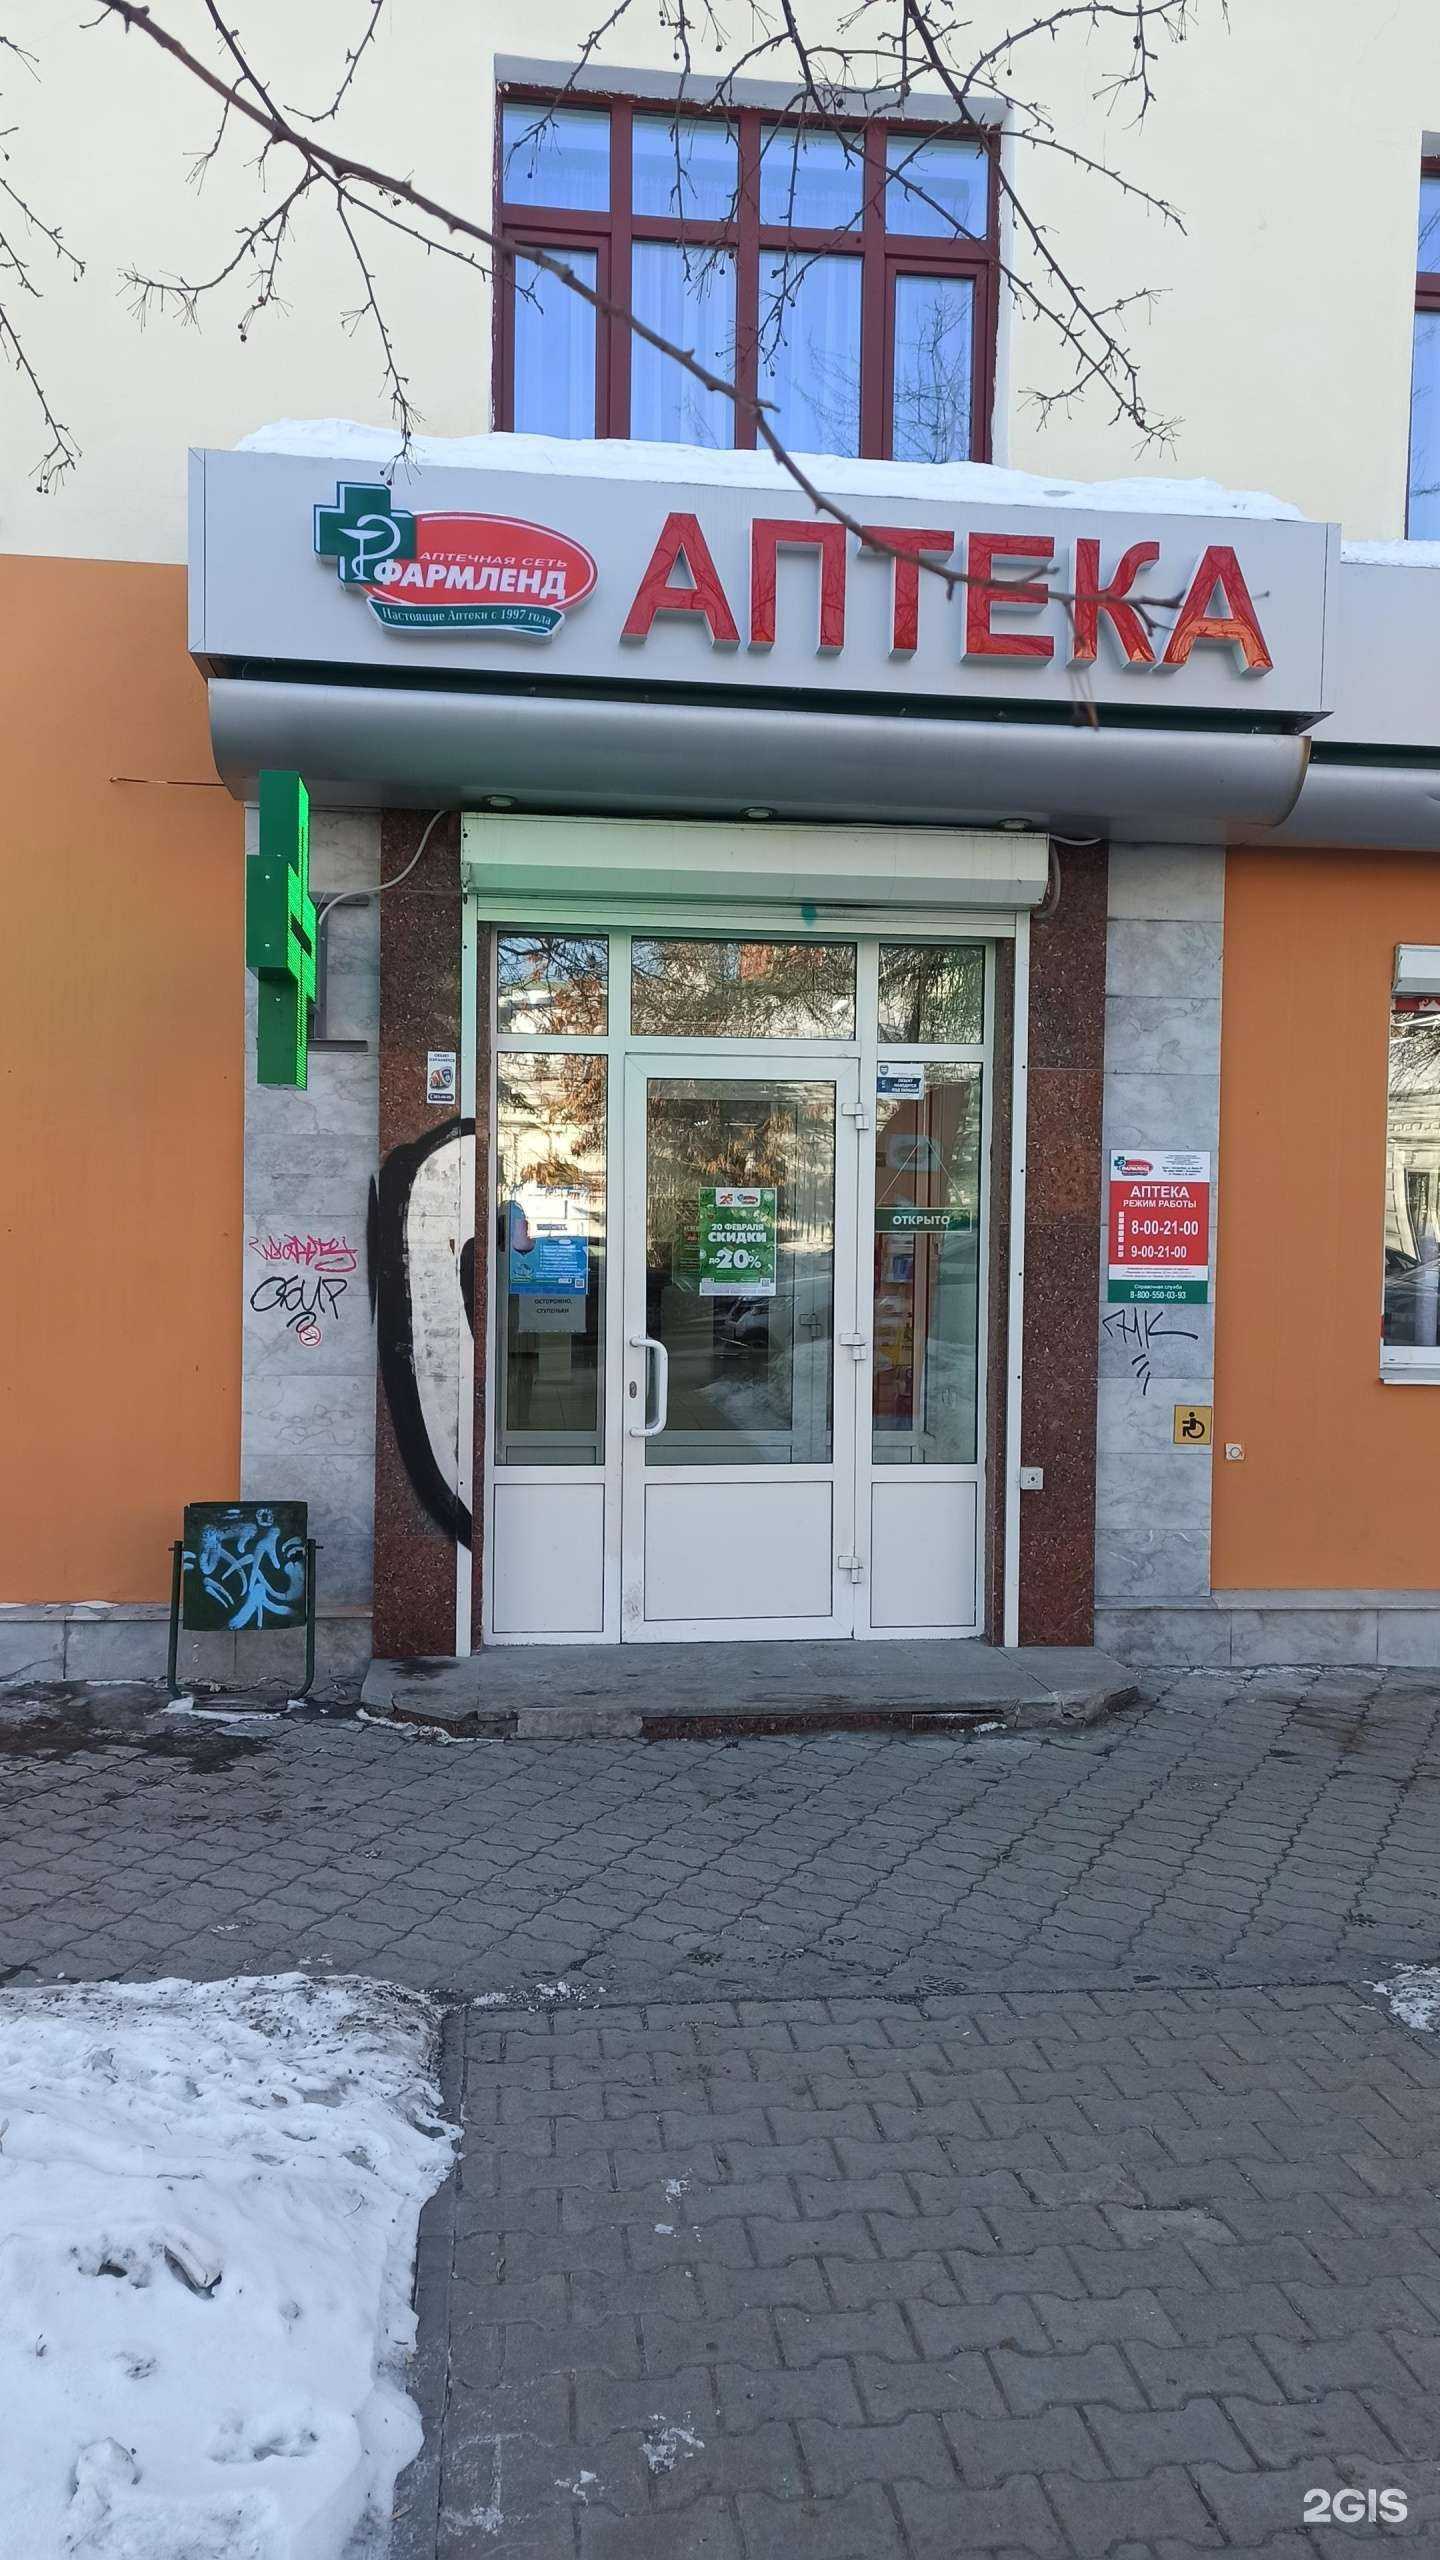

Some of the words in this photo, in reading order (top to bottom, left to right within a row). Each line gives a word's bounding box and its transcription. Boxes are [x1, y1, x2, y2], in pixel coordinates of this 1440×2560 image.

[420, 551, 516, 566] АПТЕЧНАЯ
[521, 557, 569, 568] СЕТЬ
[373, 559, 567, 600] ФАРМЛЕНД
[620, 512, 1274, 677] АПТЕКА
[382, 606, 446, 623] Настоящие
[448, 610, 489, 623] Аптеки
[490, 612, 497, 621] с
[500, 607, 526, 621] 1997
[527, 611, 552, 626] года
[1130, 1186, 1190, 1198] АПТЕКА
[1123, 1199, 1156, 1208] РЕЖИМ
[1158, 1200, 1197, 1208] РАБОТЫ
[711, 1223, 723, 1231] 20
[724, 1223, 765, 1231] ФЕВРАЛЯ
[892, 1215, 951, 1225] ОТКРЫТО
[1131, 1220, 1199, 1236] 8-00-21-00
[707, 1232, 767, 1244] СКИДКИ
[716, 1247, 761, 1268] 20%
[1131, 1245, 1187, 1258] 9-00-21-00
